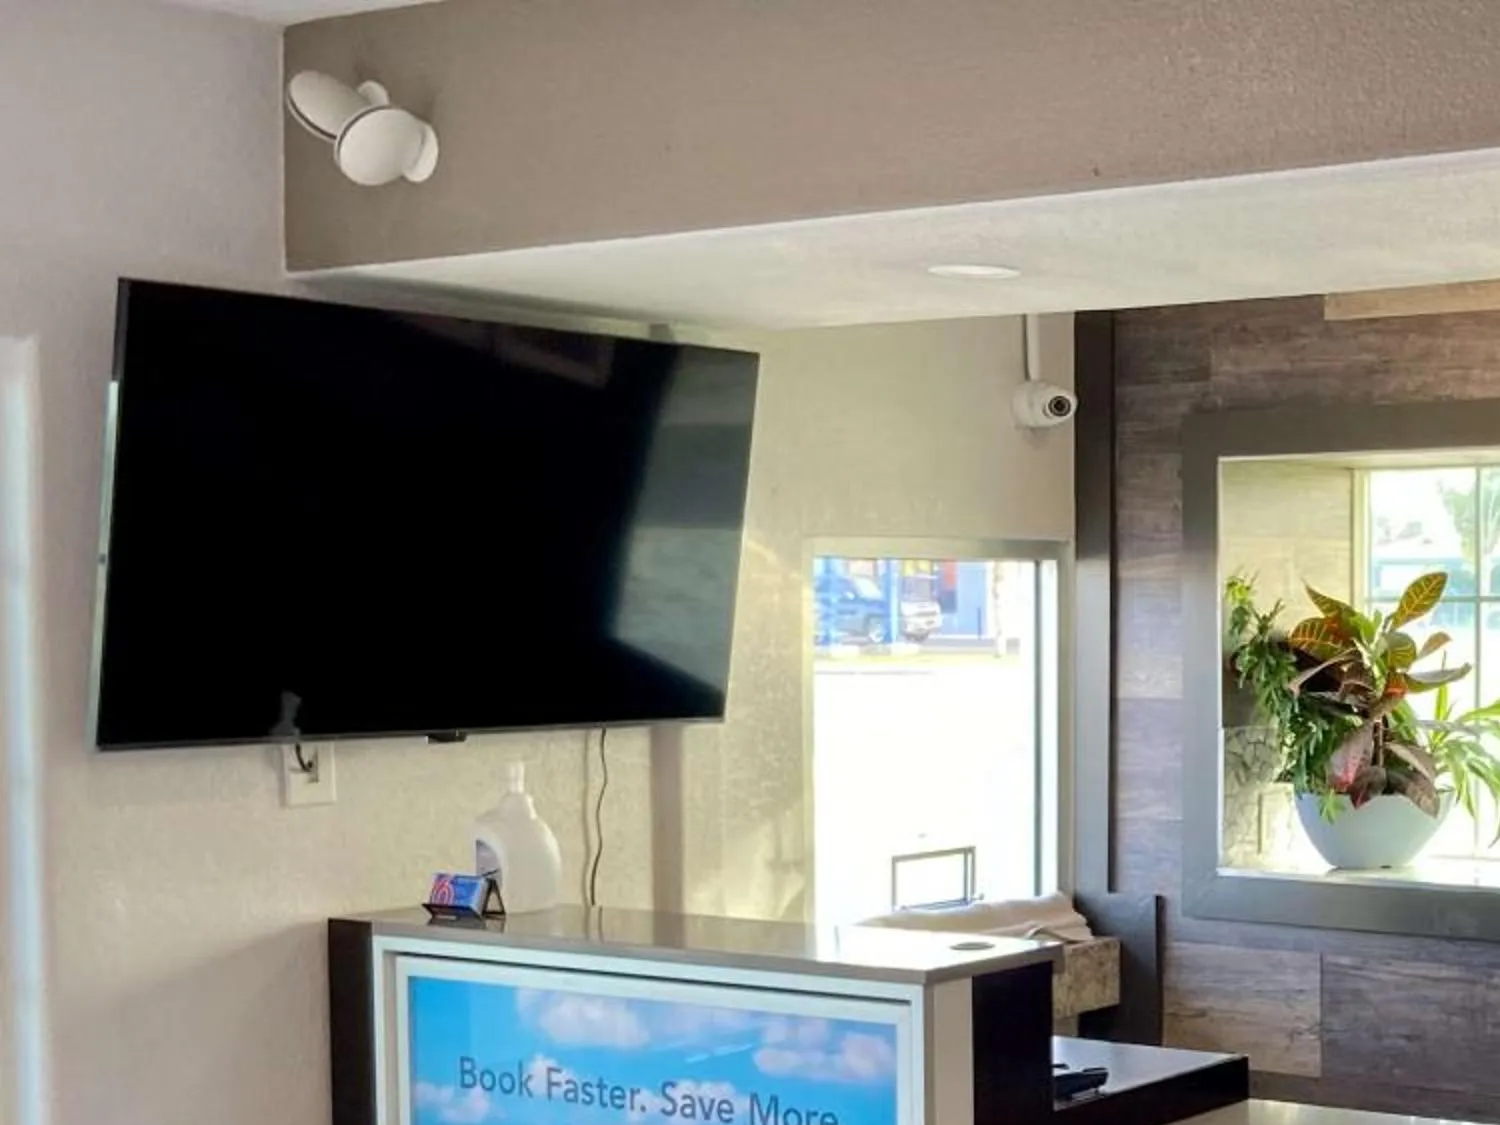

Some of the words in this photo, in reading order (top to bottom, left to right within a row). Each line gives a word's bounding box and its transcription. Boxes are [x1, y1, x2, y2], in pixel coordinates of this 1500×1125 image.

[459, 1056, 534, 1099] Book
[546, 1067, 647, 1113] Faster.
[660, 1081, 734, 1124] Save
